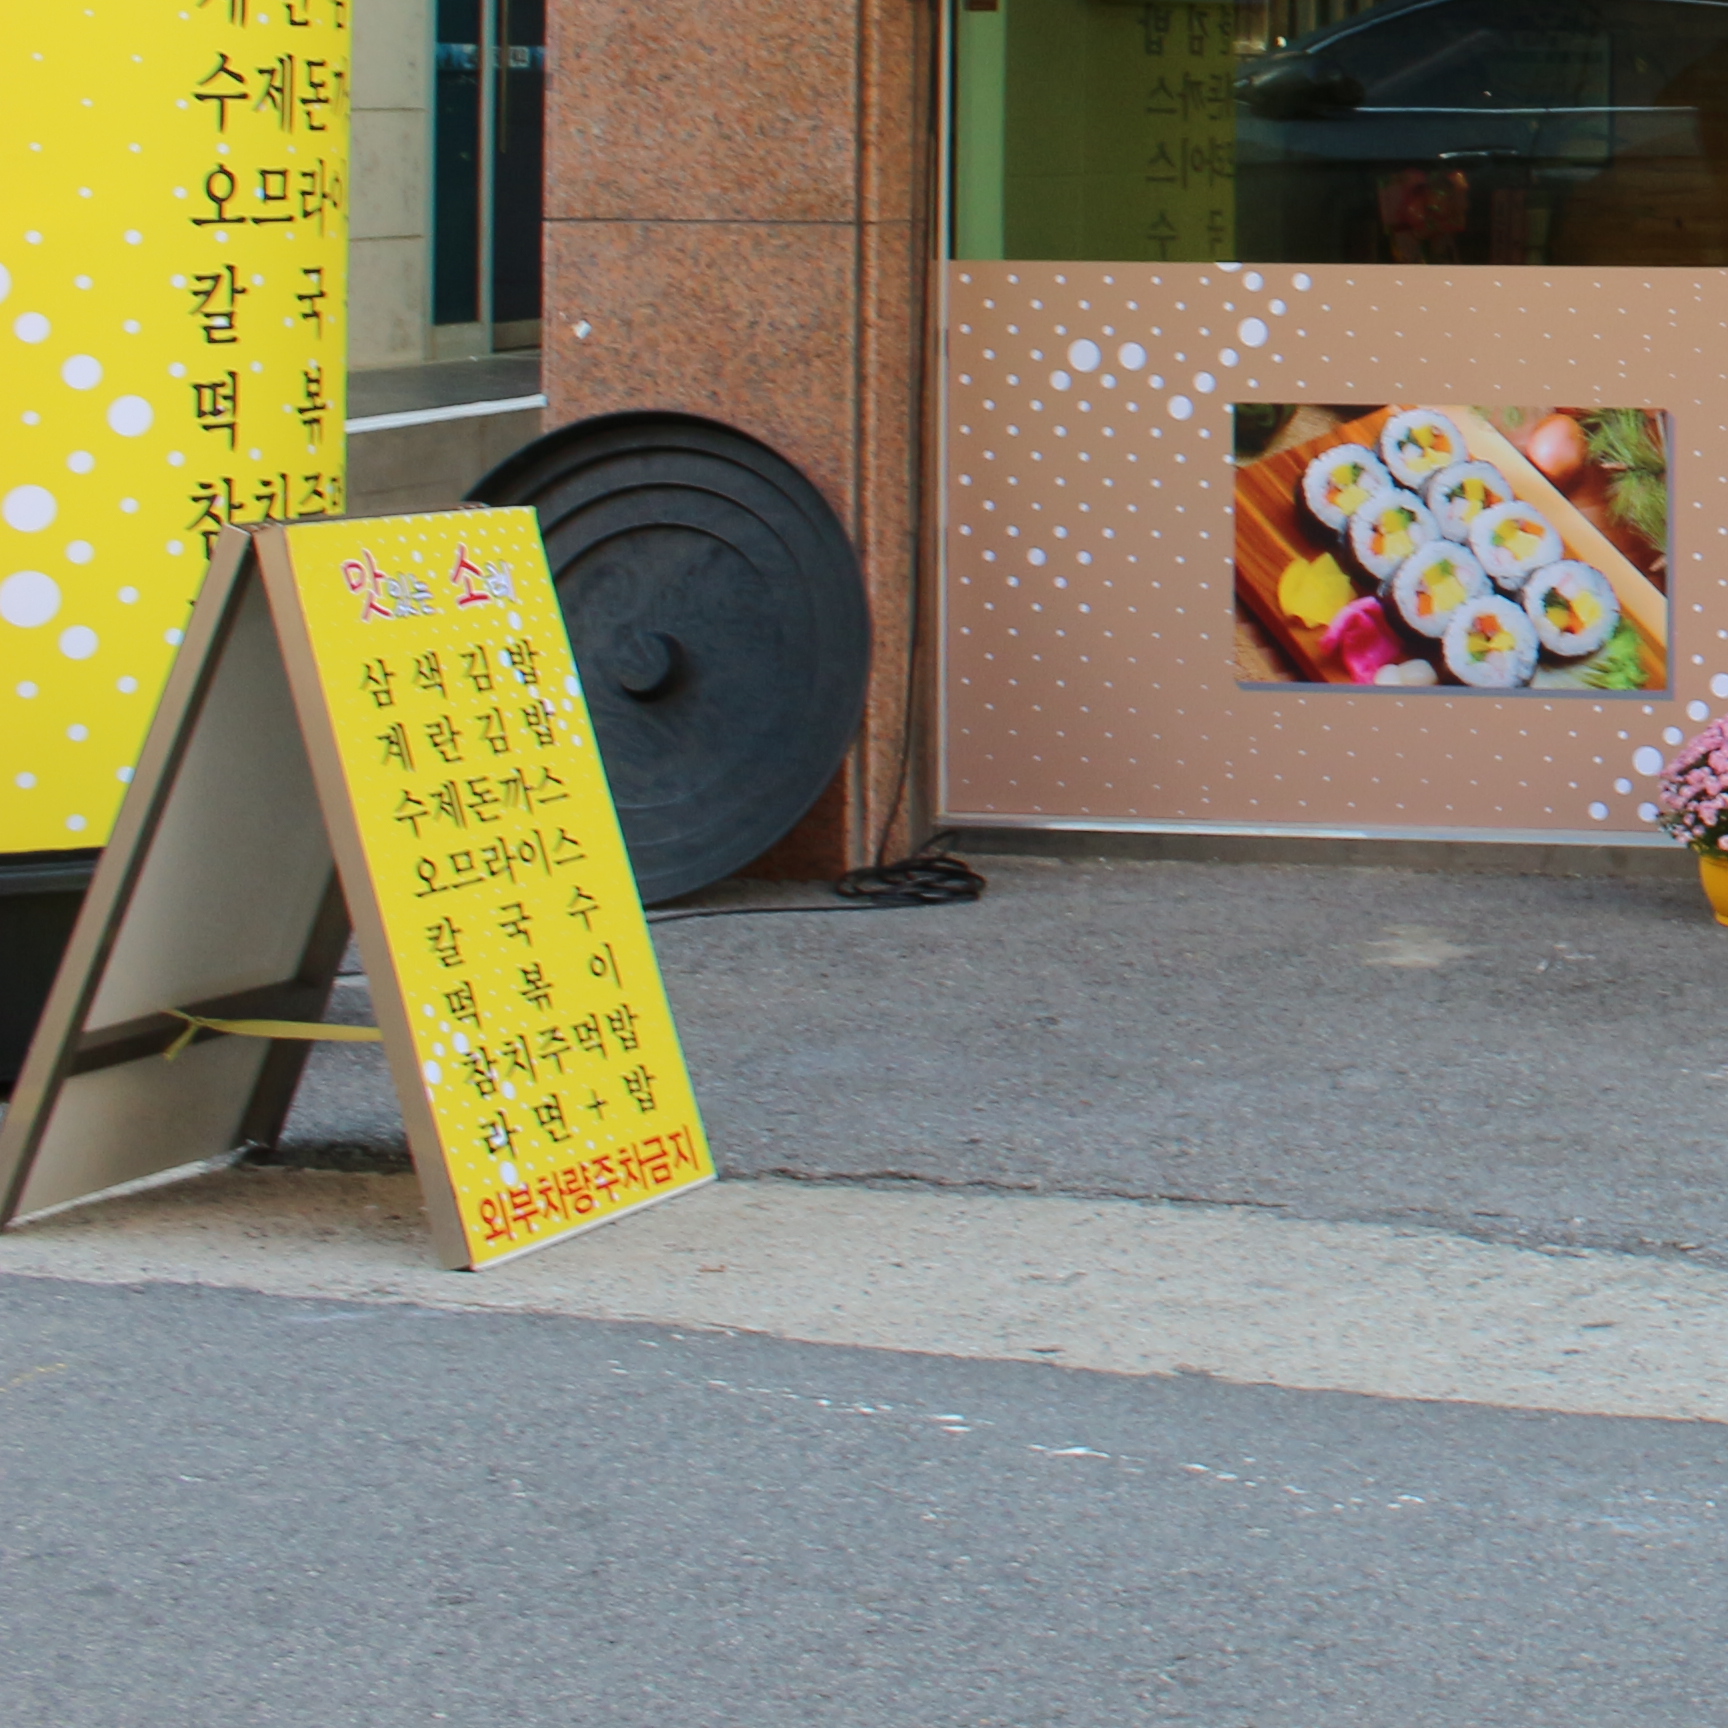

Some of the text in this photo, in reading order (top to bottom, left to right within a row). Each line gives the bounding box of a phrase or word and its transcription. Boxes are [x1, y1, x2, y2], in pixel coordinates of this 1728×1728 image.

[341, 542, 516, 621] 맛있는 소리
[358, 638, 542, 710] 삼색김밥
[376, 698, 560, 774] 계란김밥
[394, 764, 573, 838] 수제돈까스
[414, 826, 588, 900] 오므라이스
[462, 1003, 642, 1101] 참치주먹밥
[478, 1123, 701, 1246] 외부차량주차금지
